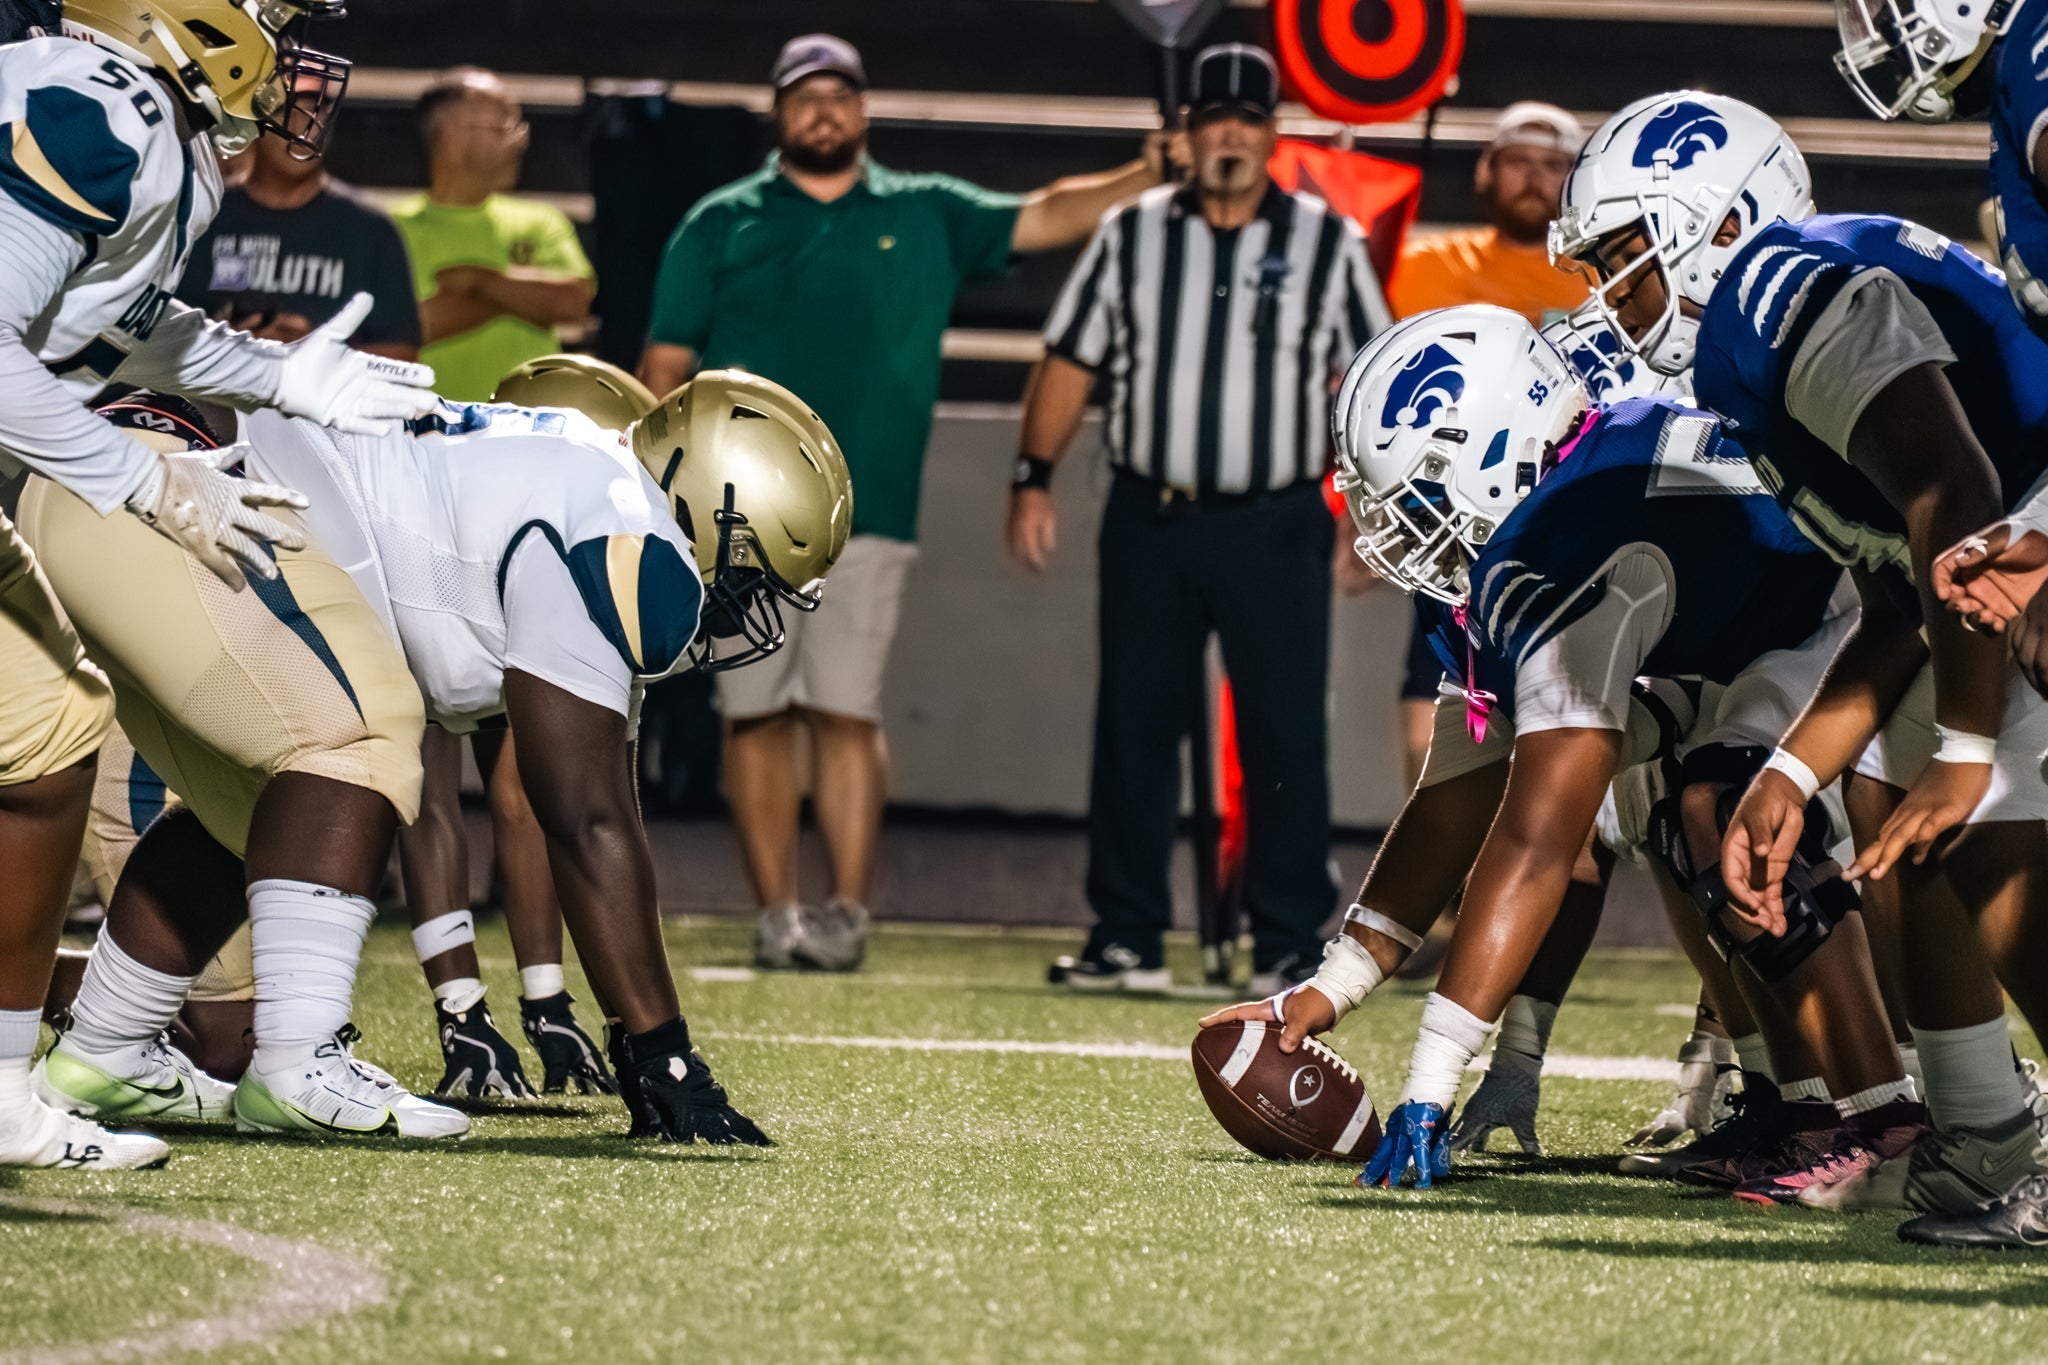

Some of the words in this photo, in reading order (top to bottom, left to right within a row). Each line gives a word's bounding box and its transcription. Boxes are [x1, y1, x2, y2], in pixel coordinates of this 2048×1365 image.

[88, 59, 163, 127] 50
[367, 360, 409, 377] BATTLE
[1527, 379, 1549, 407] 55
[1256, 1092, 1286, 1118] TEAM
